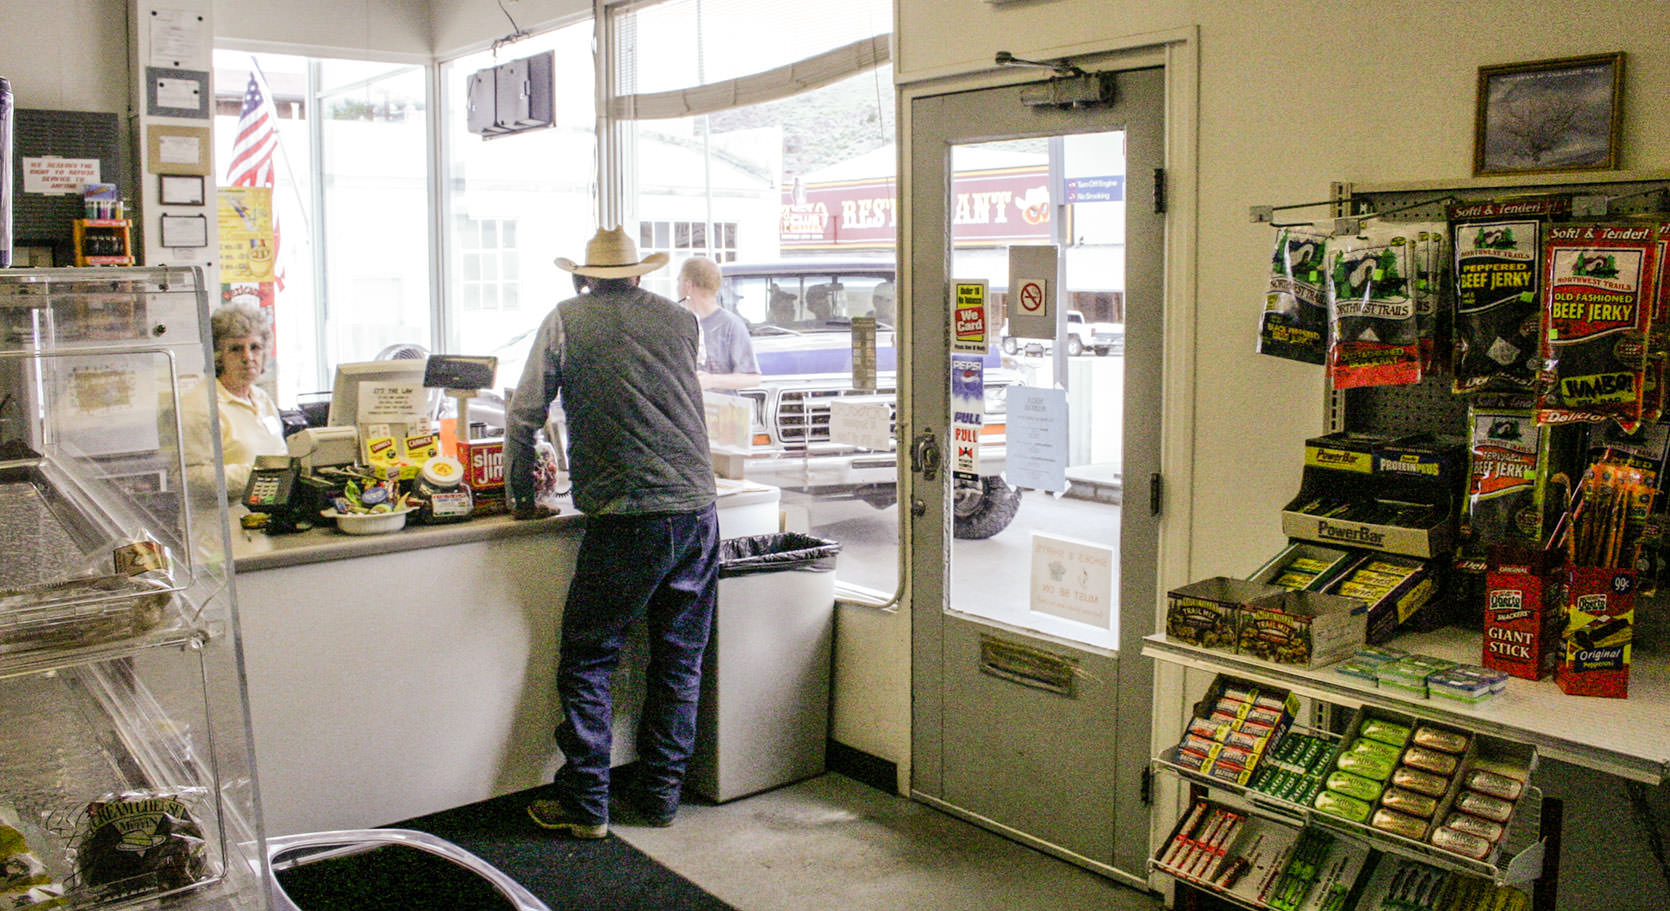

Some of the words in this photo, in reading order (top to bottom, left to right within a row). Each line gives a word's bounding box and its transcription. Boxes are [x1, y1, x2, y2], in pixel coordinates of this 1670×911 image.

[1552, 229, 1578, 239] Soft!
[1584, 228, 1594, 238] &
[1602, 228, 1649, 240] Tender!
[1464, 264, 1527, 272] PEPPERED
[1461, 273, 1486, 288] BEEF
[1490, 272, 1532, 290] JERKY
[1558, 277, 1600, 285] NORTHWEST
[1604, 280, 1631, 290] TRAILS
[1555, 292, 1572, 301] OLD
[1576, 294, 1633, 303] FASHIONED
[961, 310, 979, 320] We
[1378, 305, 1408, 316] TRAILS
[1553, 304, 1584, 319] BEEF
[1588, 304, 1632, 323] JERKY
[958, 319, 982, 332] Card
[954, 360, 981, 370] PEPSI
[1564, 374, 1632, 398] JUMBO!
[954, 412, 982, 425] PULL
[955, 428, 977, 442] PULL
[1316, 449, 1358, 463] PowerBar
[1318, 521, 1386, 543] PowerBar
[1488, 628, 1533, 644] GIANT
[1490, 641, 1530, 658] STICK
[1580, 649, 1620, 661] Original
[92, 801, 134, 828] CREAM
